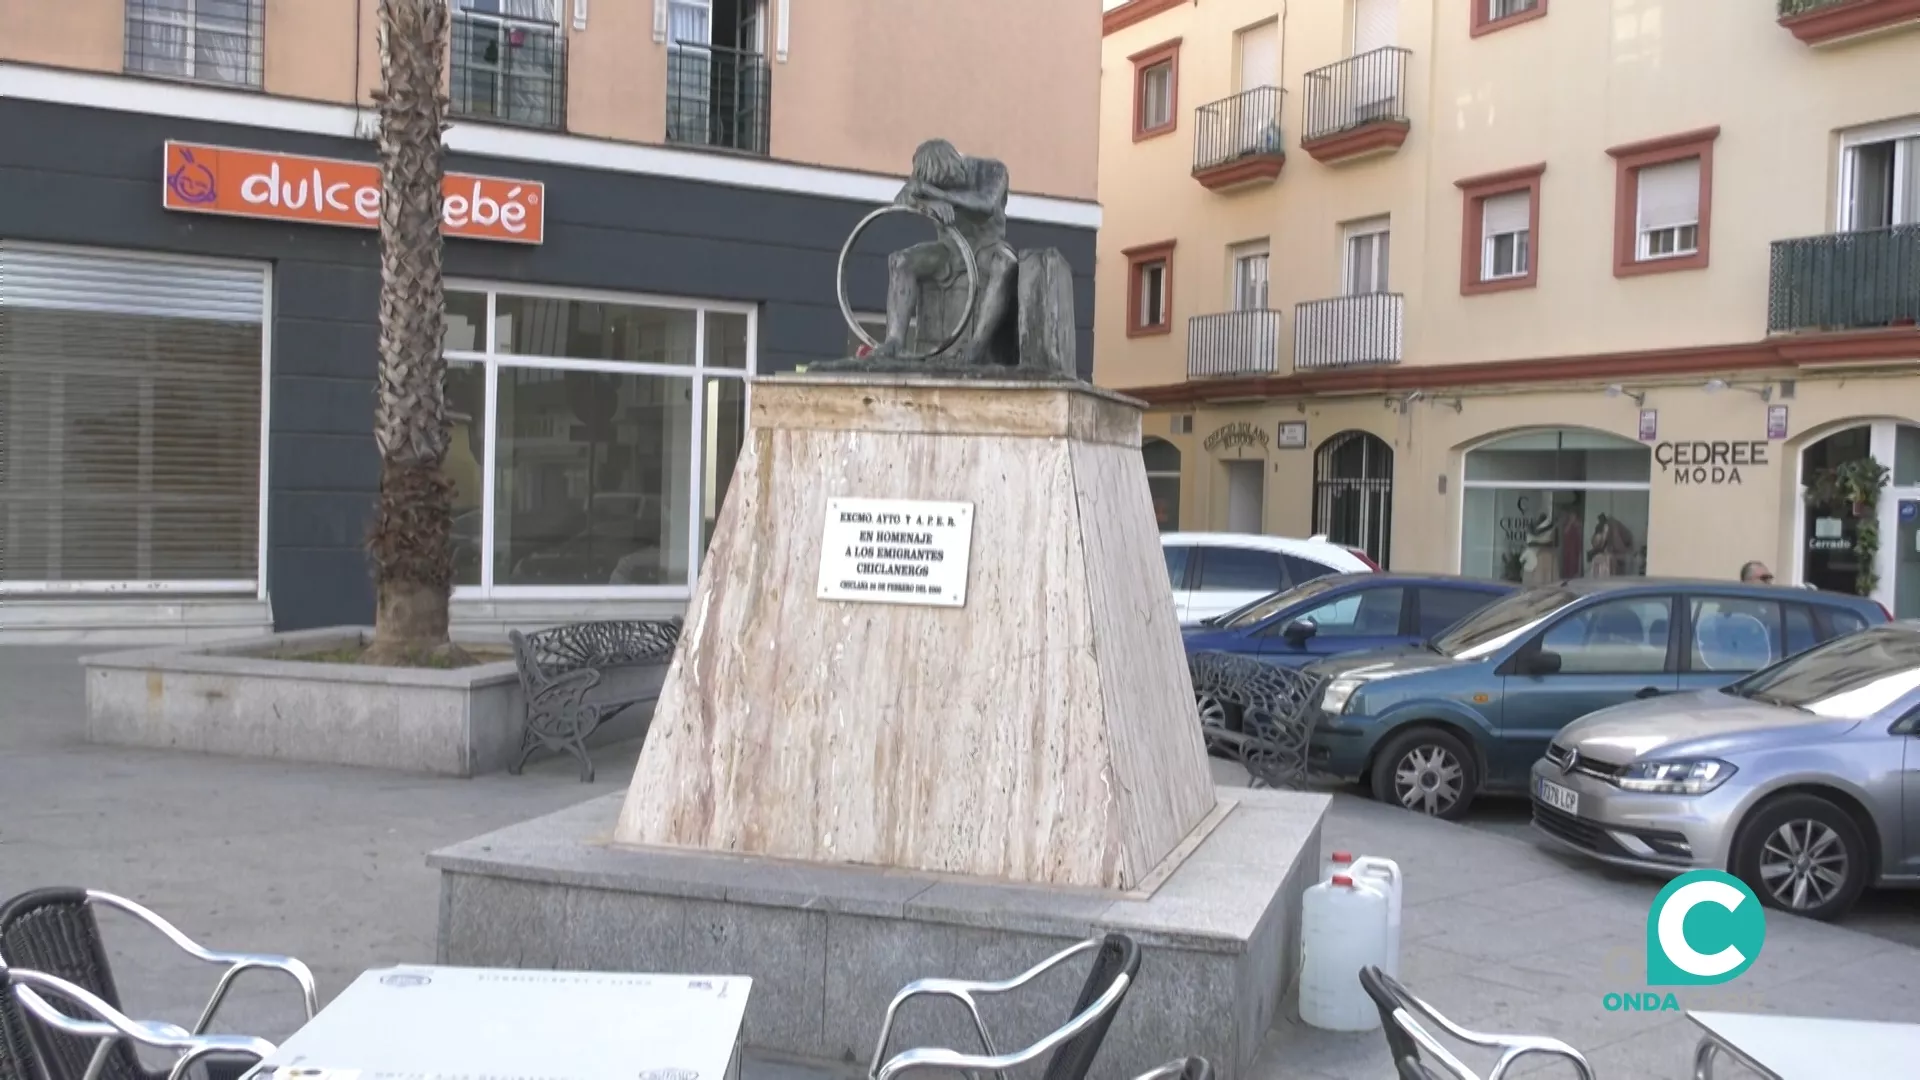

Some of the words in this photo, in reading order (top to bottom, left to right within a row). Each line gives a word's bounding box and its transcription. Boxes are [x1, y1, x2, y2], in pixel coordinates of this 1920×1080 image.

[240, 161, 382, 220] dulce
[442, 179, 527, 234] ebé
[1674, 467, 1742, 485] MODA
[859, 530, 874, 542] EN
[876, 530, 933, 545] HOMENAJE
[1808, 537, 1852, 550] Cerrado
[845, 545, 852, 557] A
[854, 546, 874, 559] LOS
[876, 546, 944, 562] EMIGRANTES
[856, 562, 929, 577] CHICLANEROS
